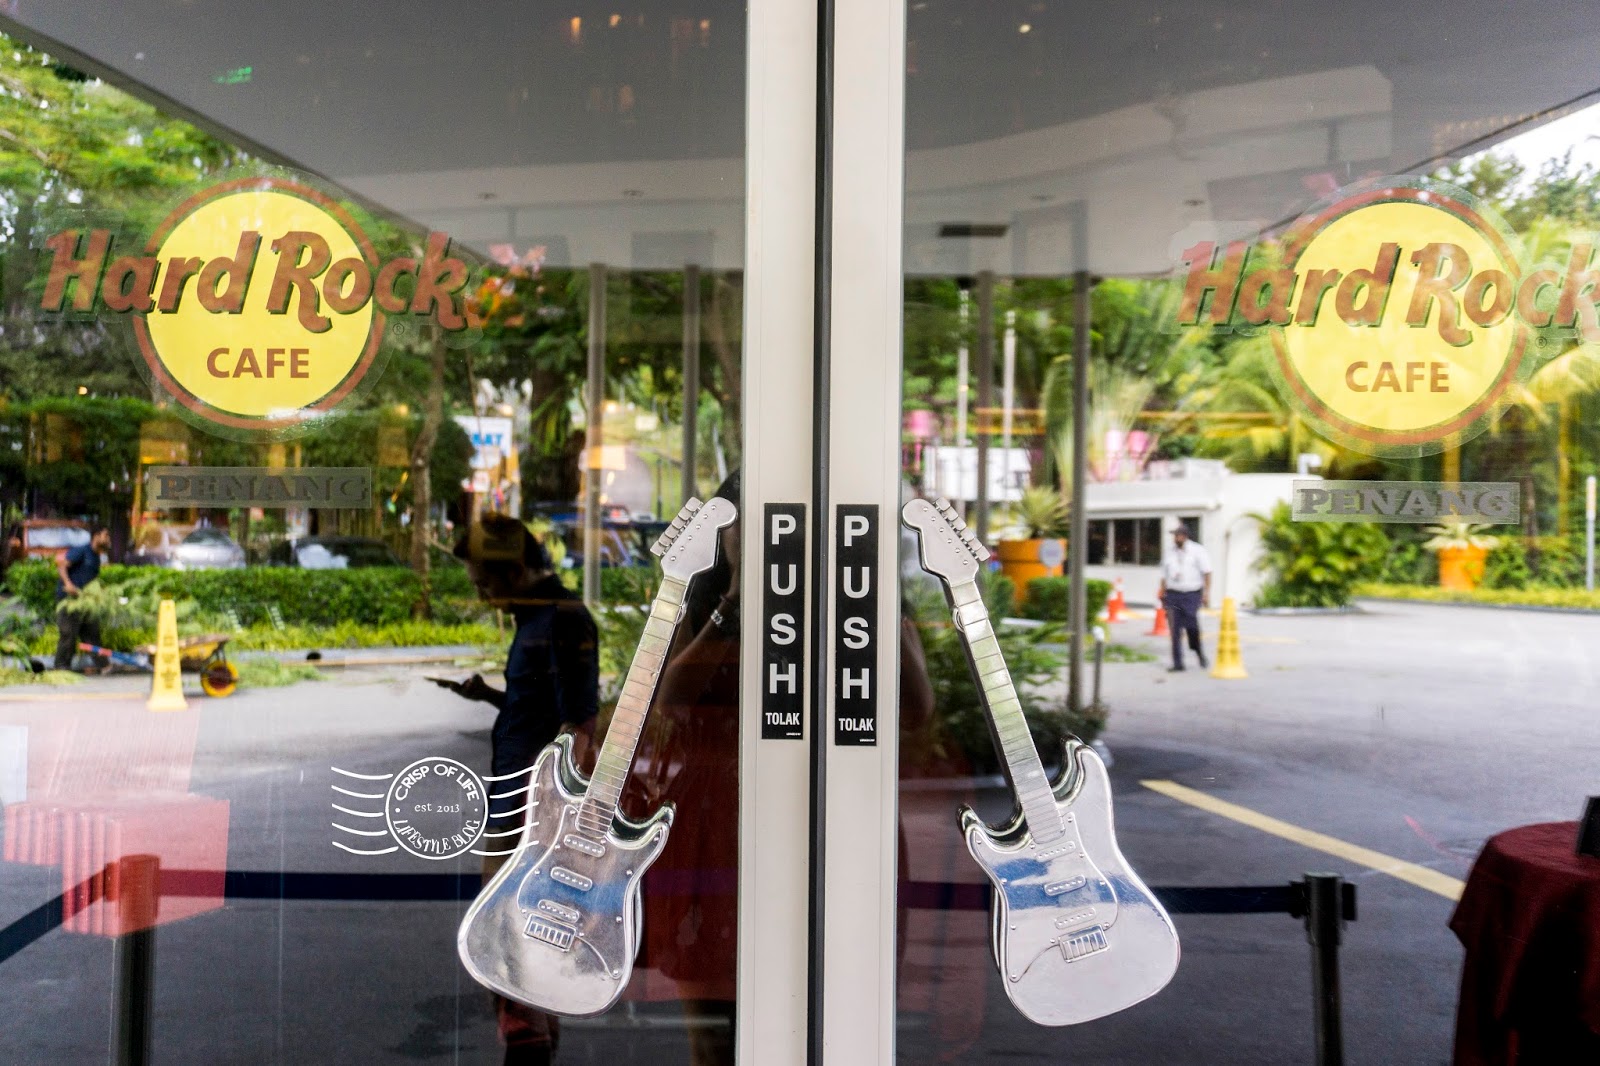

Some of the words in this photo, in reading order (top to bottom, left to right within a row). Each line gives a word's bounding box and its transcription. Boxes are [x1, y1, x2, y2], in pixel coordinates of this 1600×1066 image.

[41, 229, 261, 315] Hard
[266, 230, 471, 333] Rock
[1176, 240, 1403, 328] Hard
[1406, 242, 1600, 348] Rock
[206, 347, 310, 379] CAFE
[1344, 361, 1450, 393] CAFE
[156, 474, 368, 501] PENANG
[1296, 488, 1514, 517] PENANG
[769, 514, 797, 694] PUSH
[842, 515, 870, 700] PUSH
[765, 712, 800, 726] TOLAK
[839, 717, 874, 732] TOLAK
